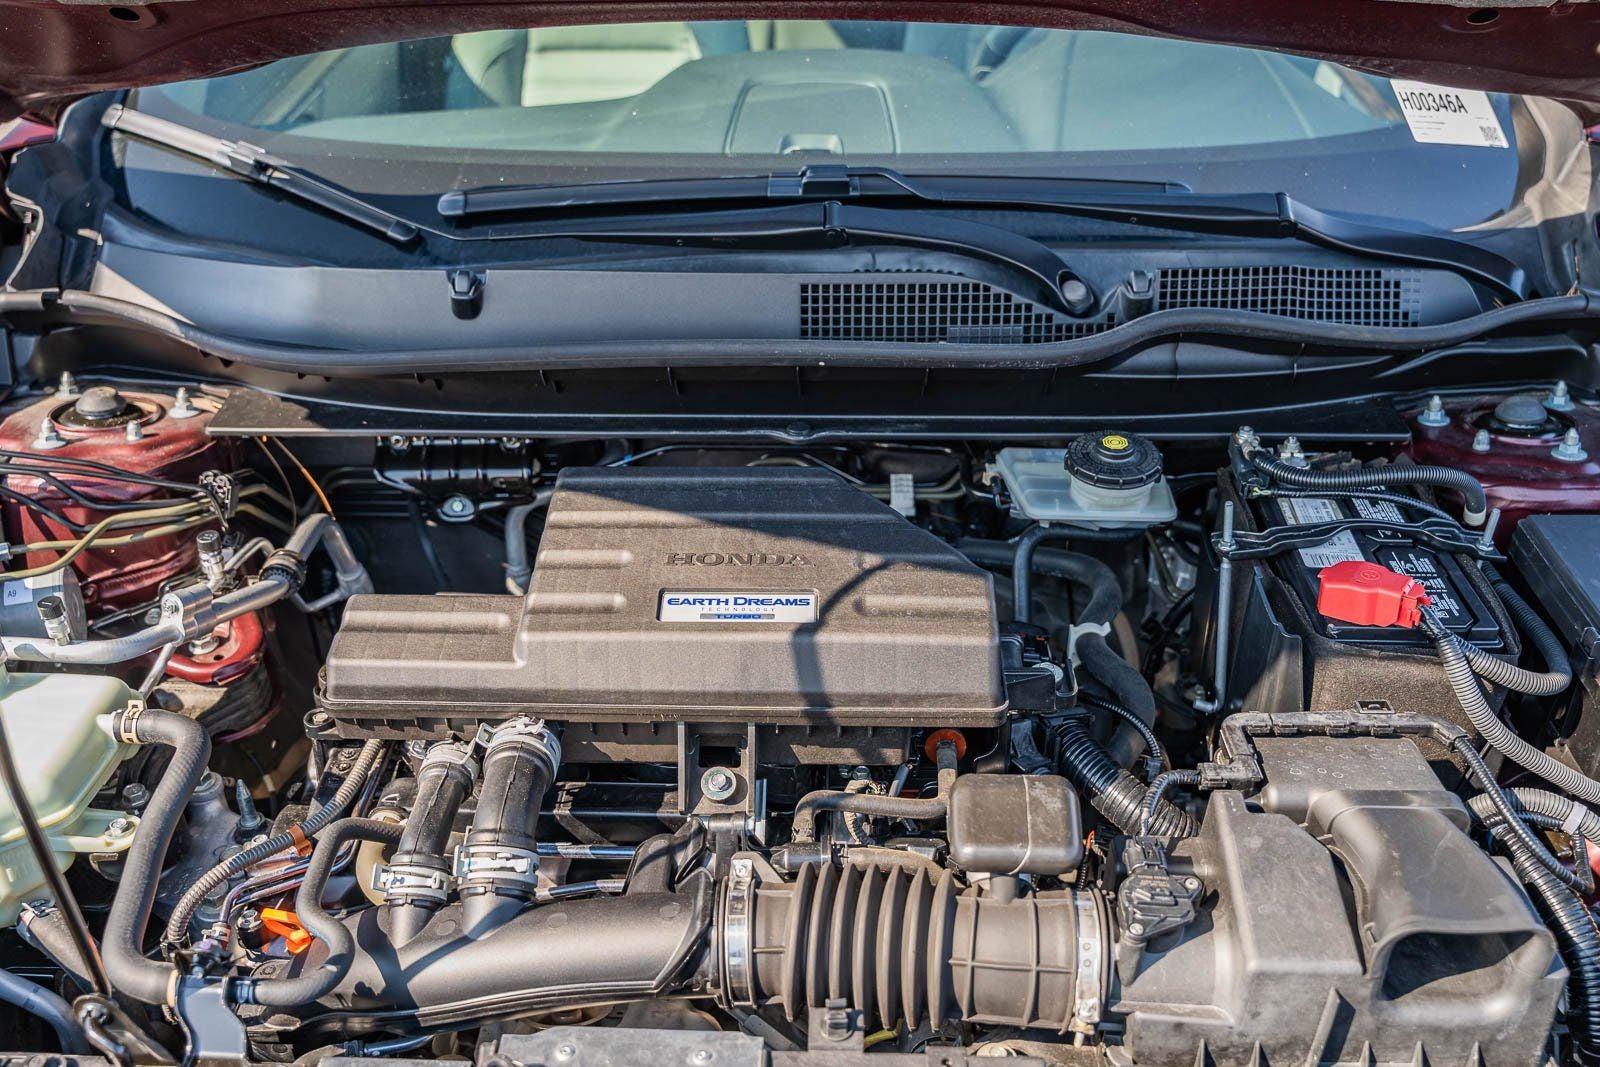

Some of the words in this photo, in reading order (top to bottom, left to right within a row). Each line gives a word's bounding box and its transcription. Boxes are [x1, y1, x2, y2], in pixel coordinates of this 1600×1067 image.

[1399, 91, 1469, 114] H00346A
[662, 552, 816, 567] HONDA
[667, 597, 729, 606] EARTH
[733, 596, 811, 606] DREAMS
